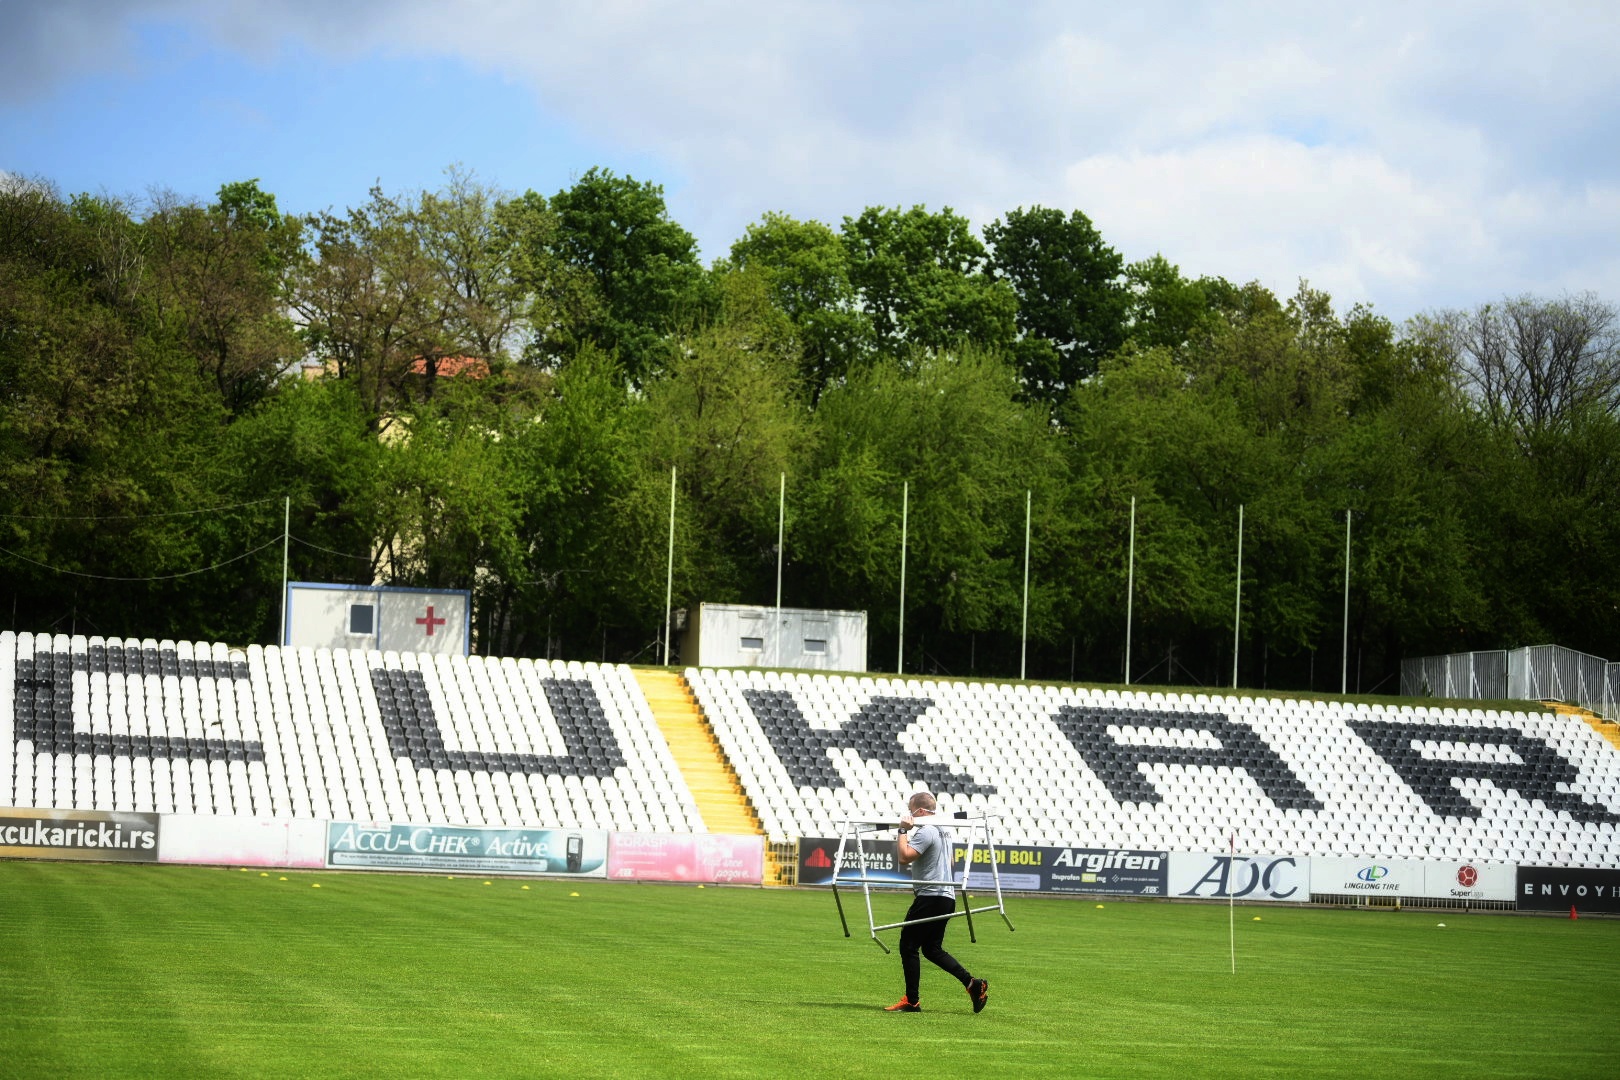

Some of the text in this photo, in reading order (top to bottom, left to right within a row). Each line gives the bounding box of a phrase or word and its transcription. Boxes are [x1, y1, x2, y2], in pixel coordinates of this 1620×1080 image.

[485, 836, 548, 856] Active
[886, 853, 893, 861] &
[1010, 850, 1042, 865] BOL!
[1524, 883, 1605, 897] ENVOY
